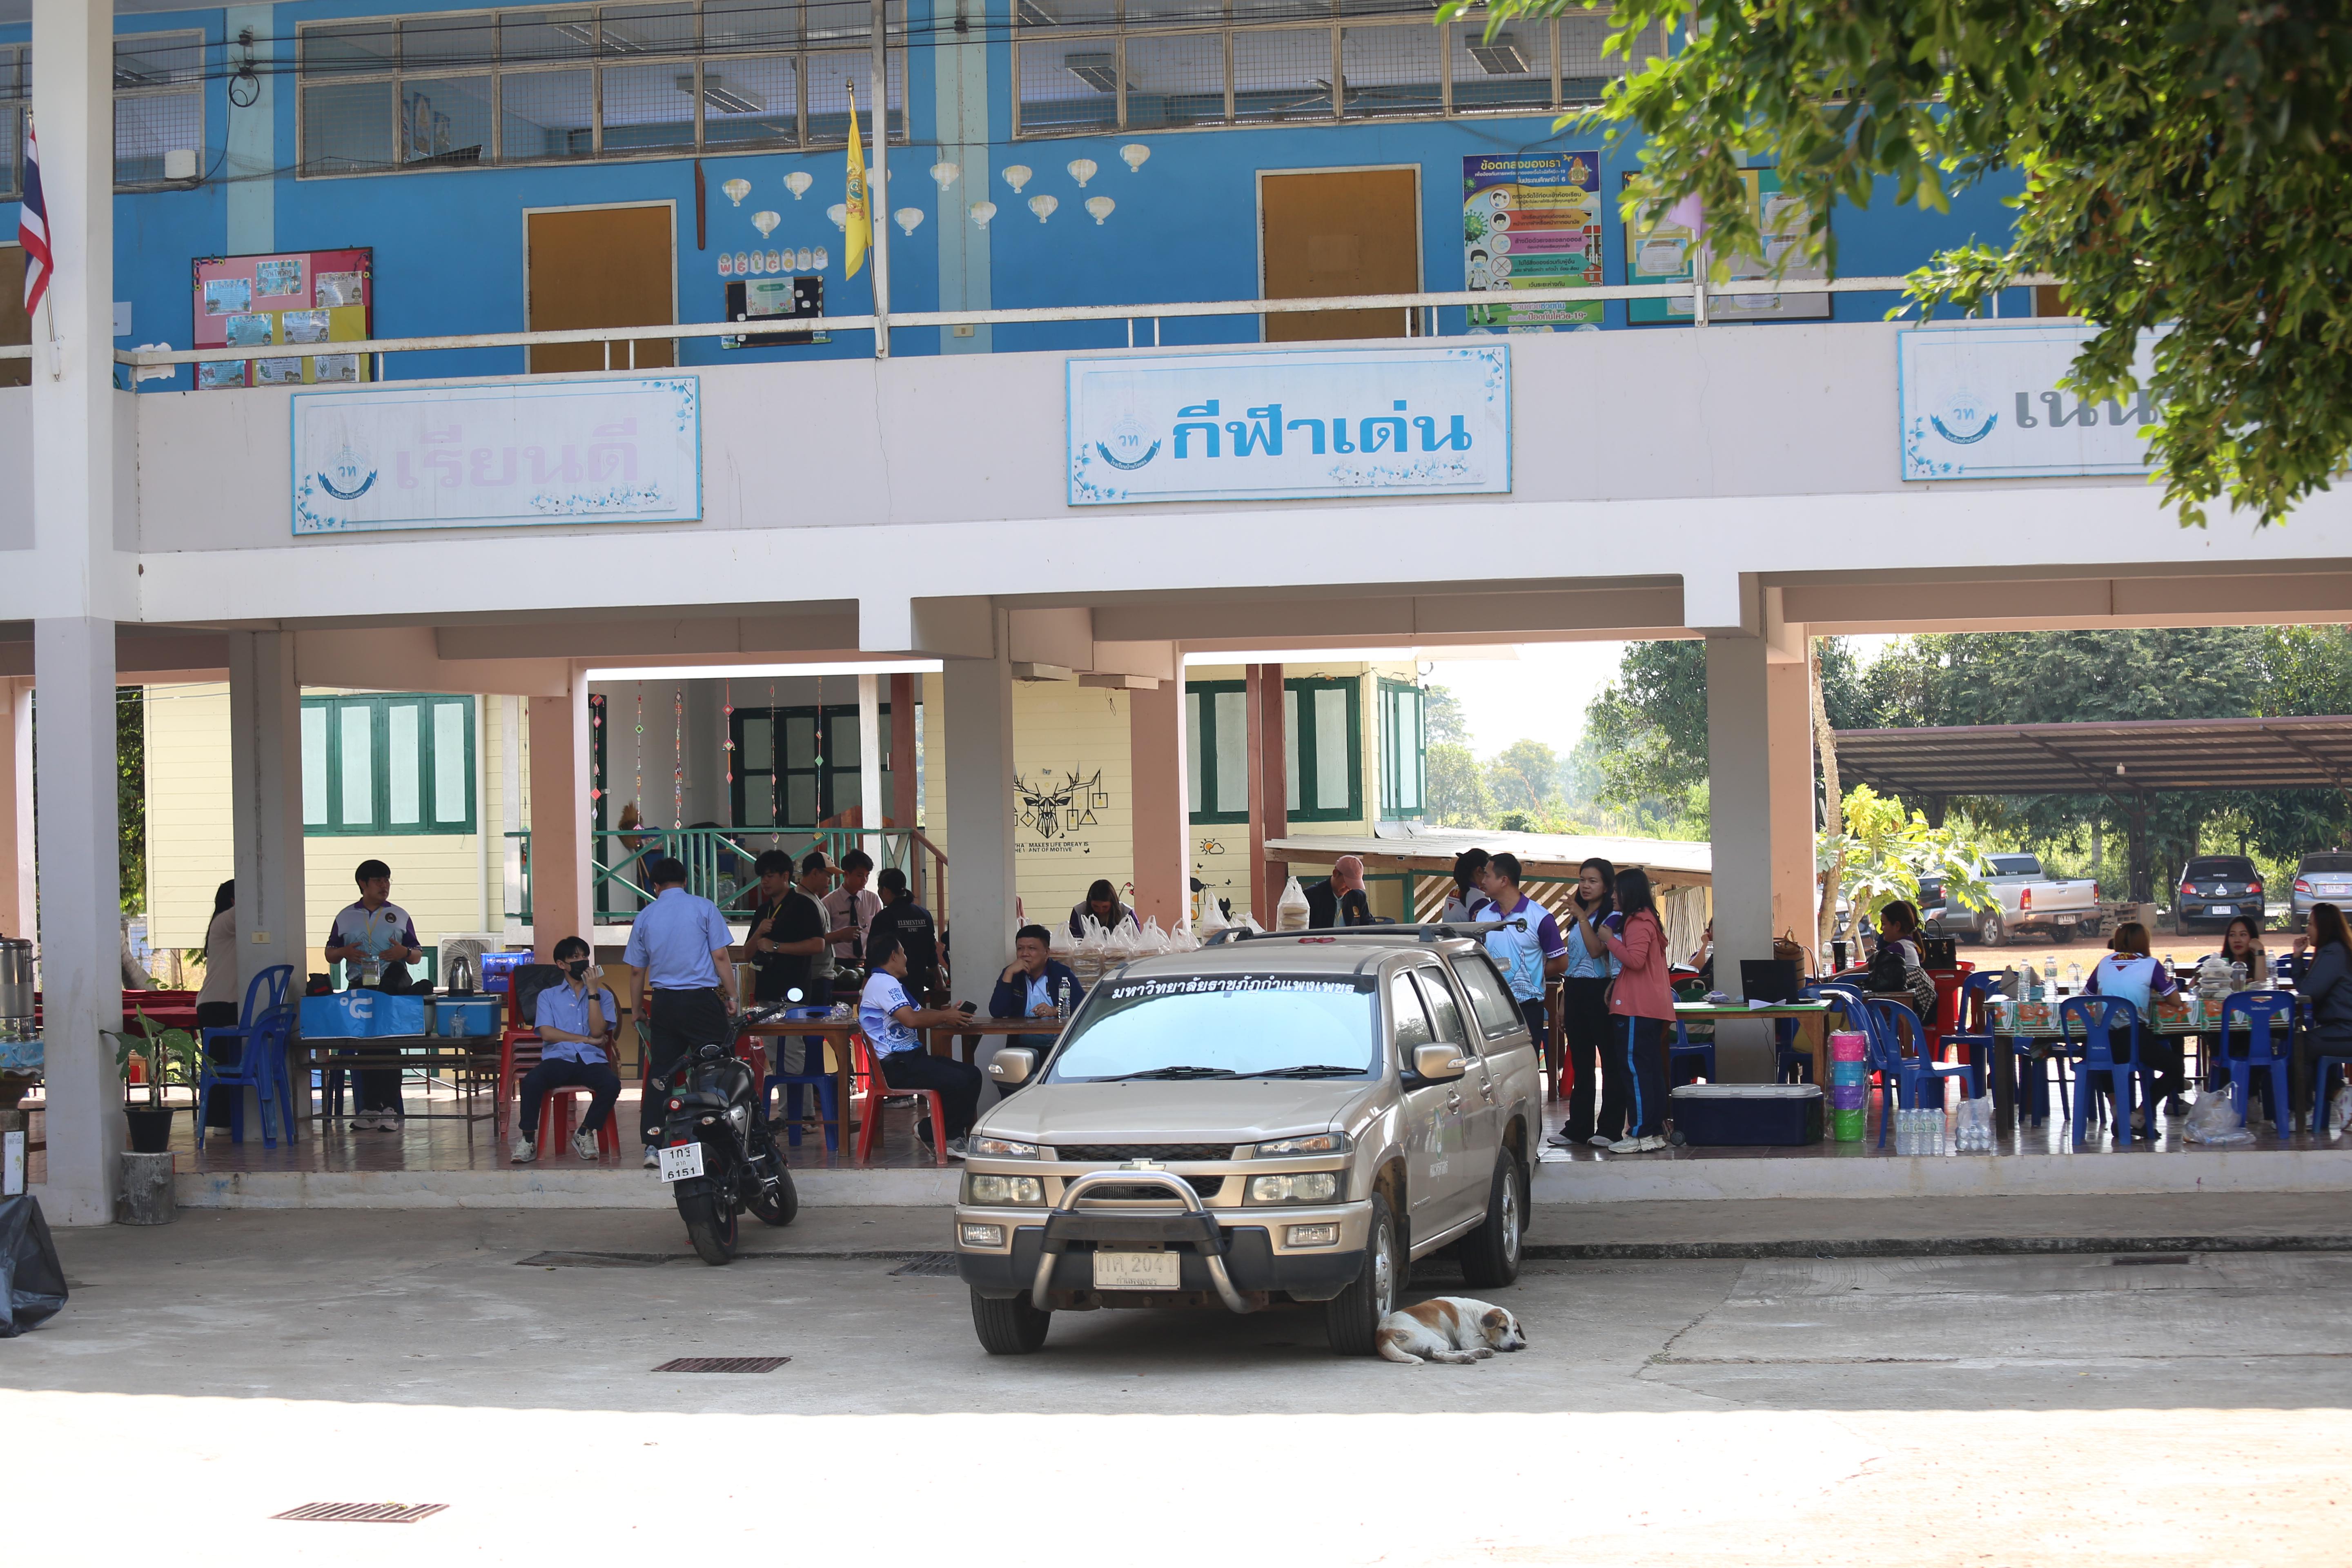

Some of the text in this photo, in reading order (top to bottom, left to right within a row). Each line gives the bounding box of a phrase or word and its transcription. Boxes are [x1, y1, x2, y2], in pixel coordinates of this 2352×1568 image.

[1481, 159, 1561, 170] ข้อตกลงของเรา
[1172, 399, 1473, 460] กีฬาเด่น
[396, 417, 638, 490] เรียนดี
[1111, 976, 1356, 999] มหาวิทยาลัยราชภัฏกำแพงเพชร
[668, 1167, 695, 1179] 6151
[1131, 1254, 1174, 1273] 2041
[1116, 1275, 1158, 1285] กำแพงเพชร
